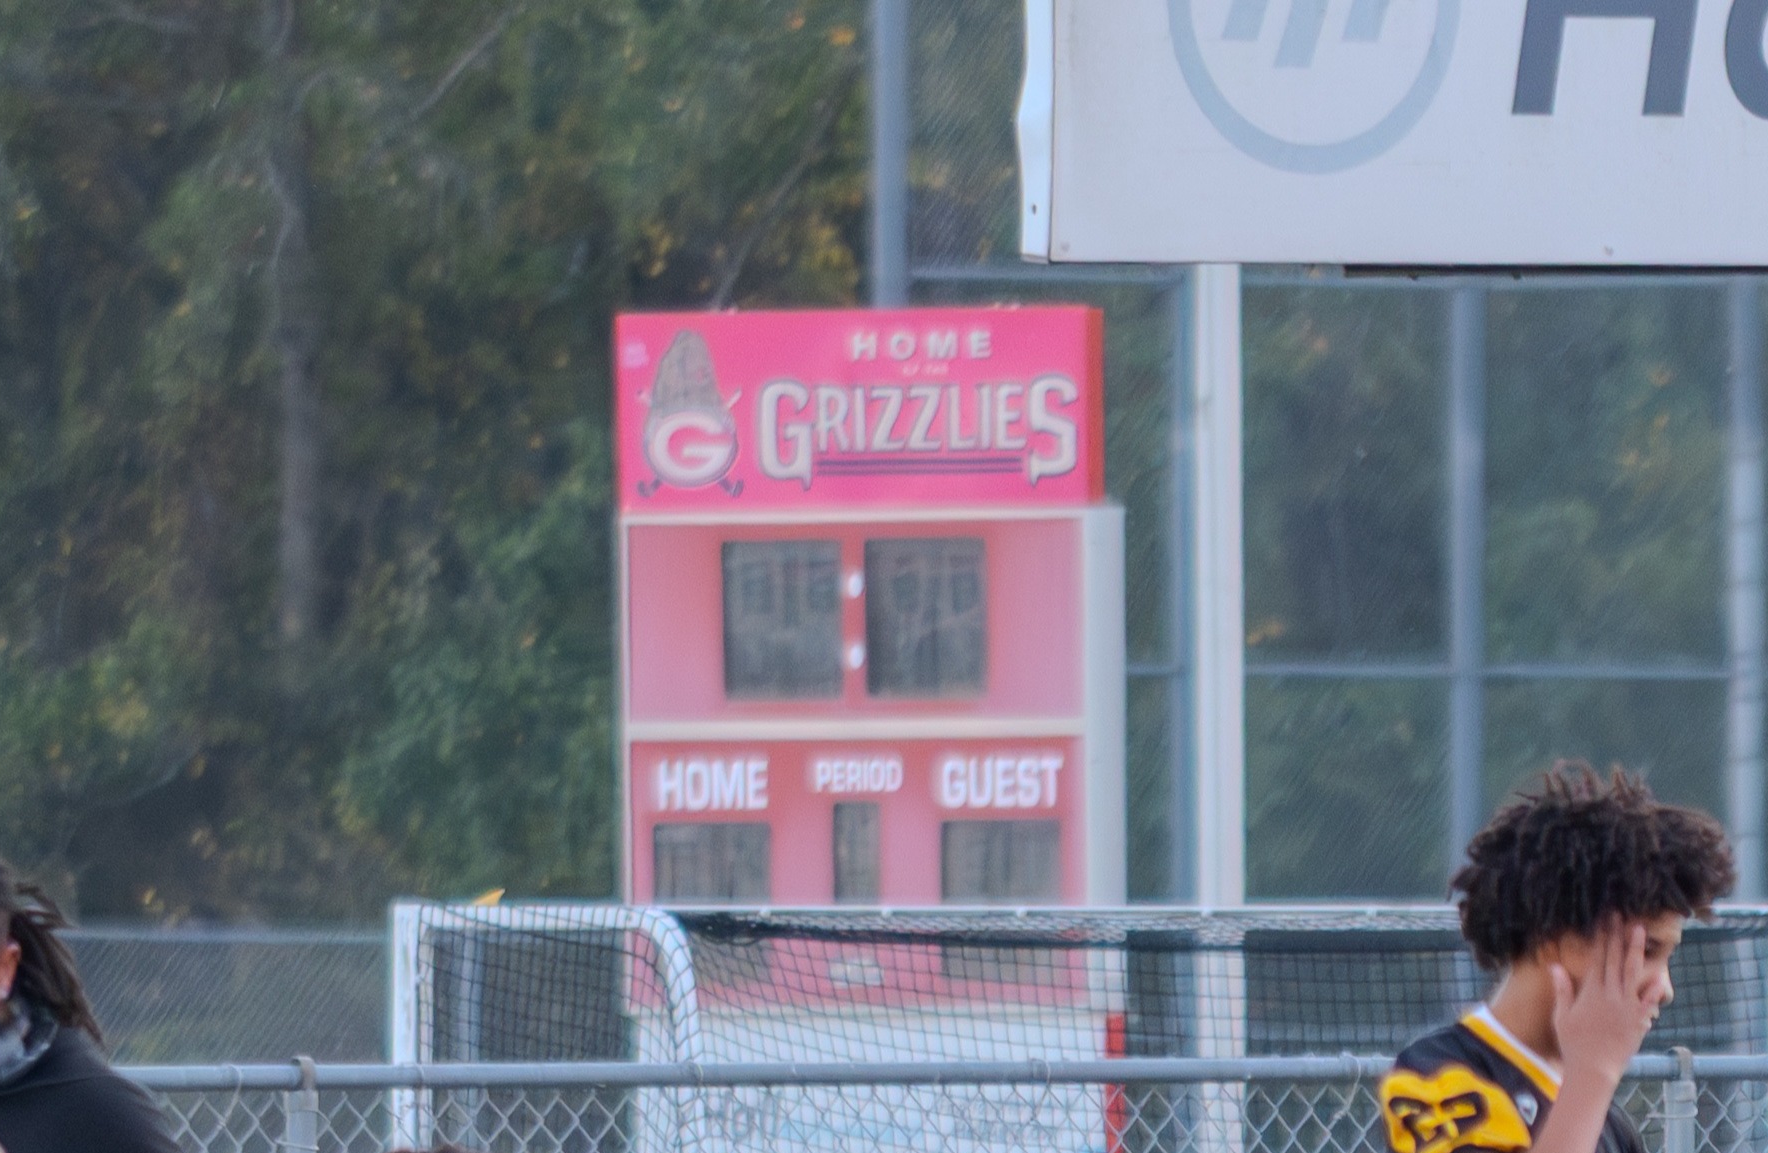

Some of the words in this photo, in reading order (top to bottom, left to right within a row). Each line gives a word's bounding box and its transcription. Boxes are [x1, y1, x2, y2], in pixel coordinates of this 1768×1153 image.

[848, 328, 993, 361] HOME
[755, 374, 1079, 490] GRIZZLIES
[653, 757, 770, 811] HOME
[809, 756, 905, 794] PERIOD
[936, 753, 1065, 810] GUEST
